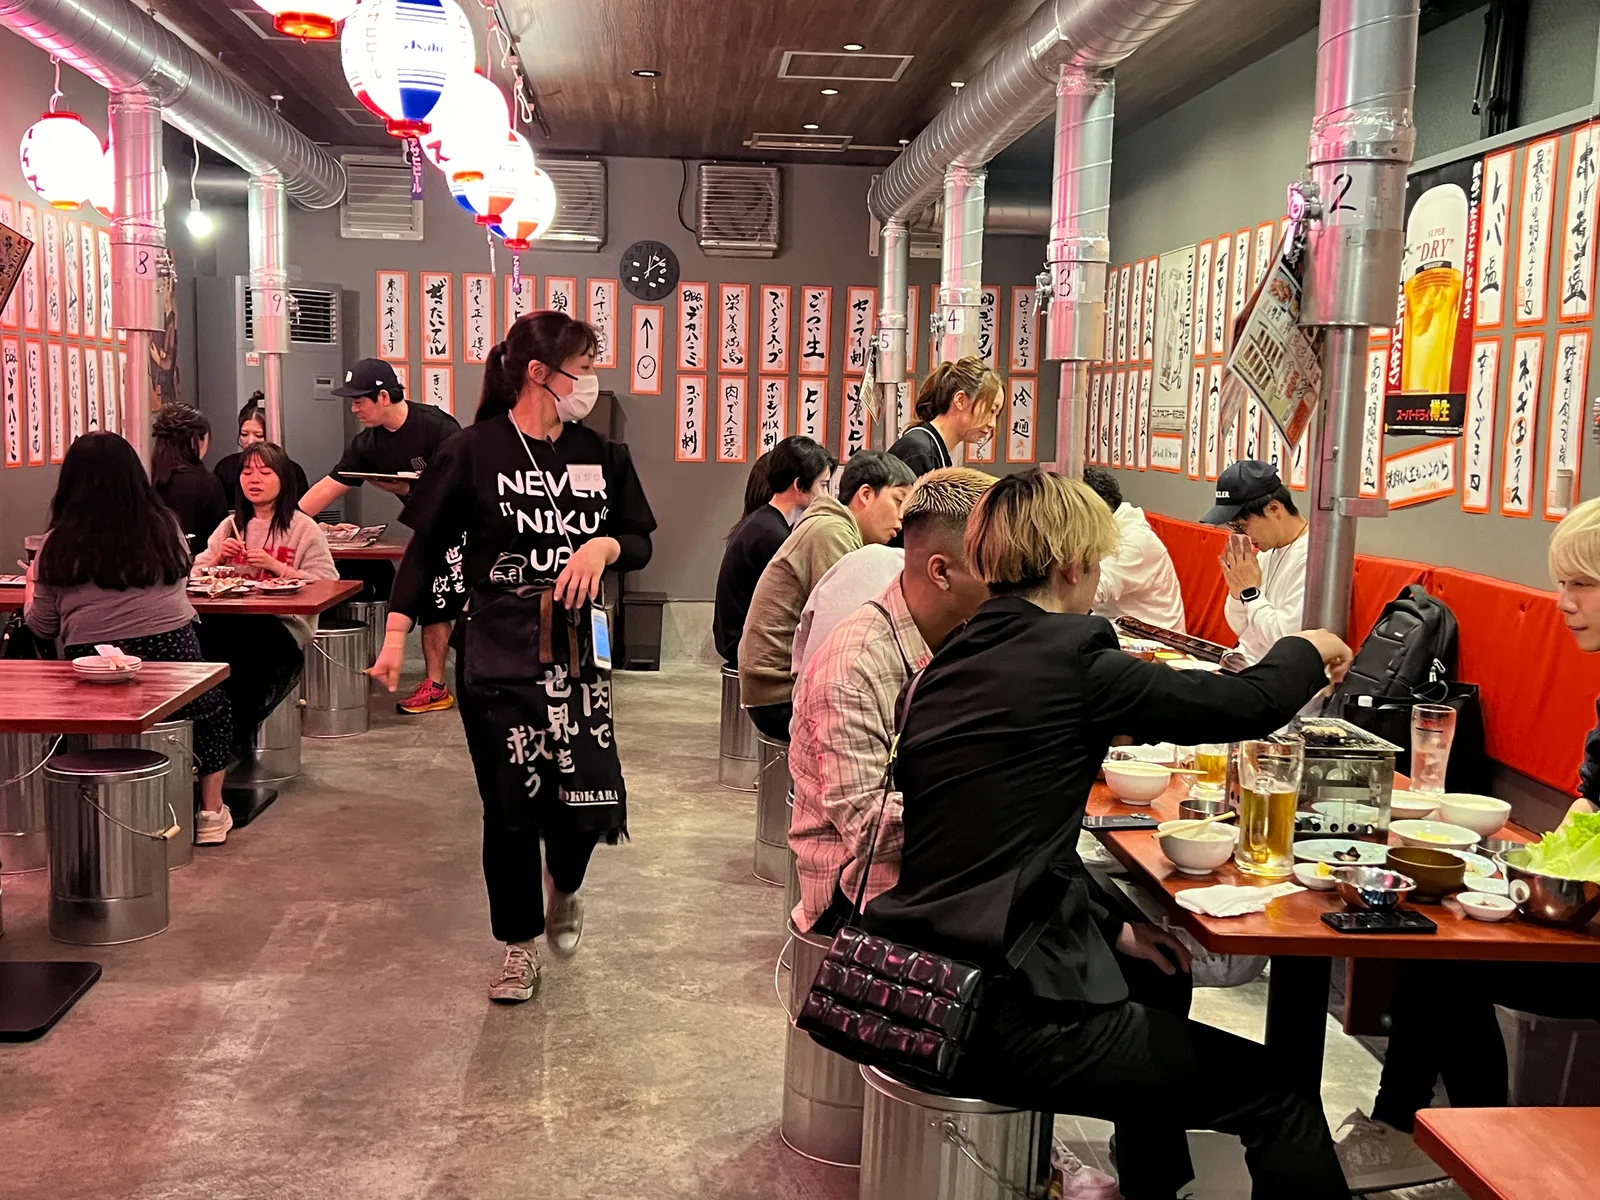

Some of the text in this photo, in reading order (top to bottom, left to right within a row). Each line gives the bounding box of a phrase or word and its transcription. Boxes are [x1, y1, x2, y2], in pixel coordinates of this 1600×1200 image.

[1328, 173, 1357, 213] 2
[1428, 227, 1445, 238] SUPER
[1480, 171, 1505, 293] レバ塩
[135, 250, 149, 275] 8
[1059, 268, 1071, 297] 3
[273, 293, 282, 312] 9
[947, 309, 960, 331] 4
[881, 333, 890, 349] 5
[530, 547, 574, 572] UP
